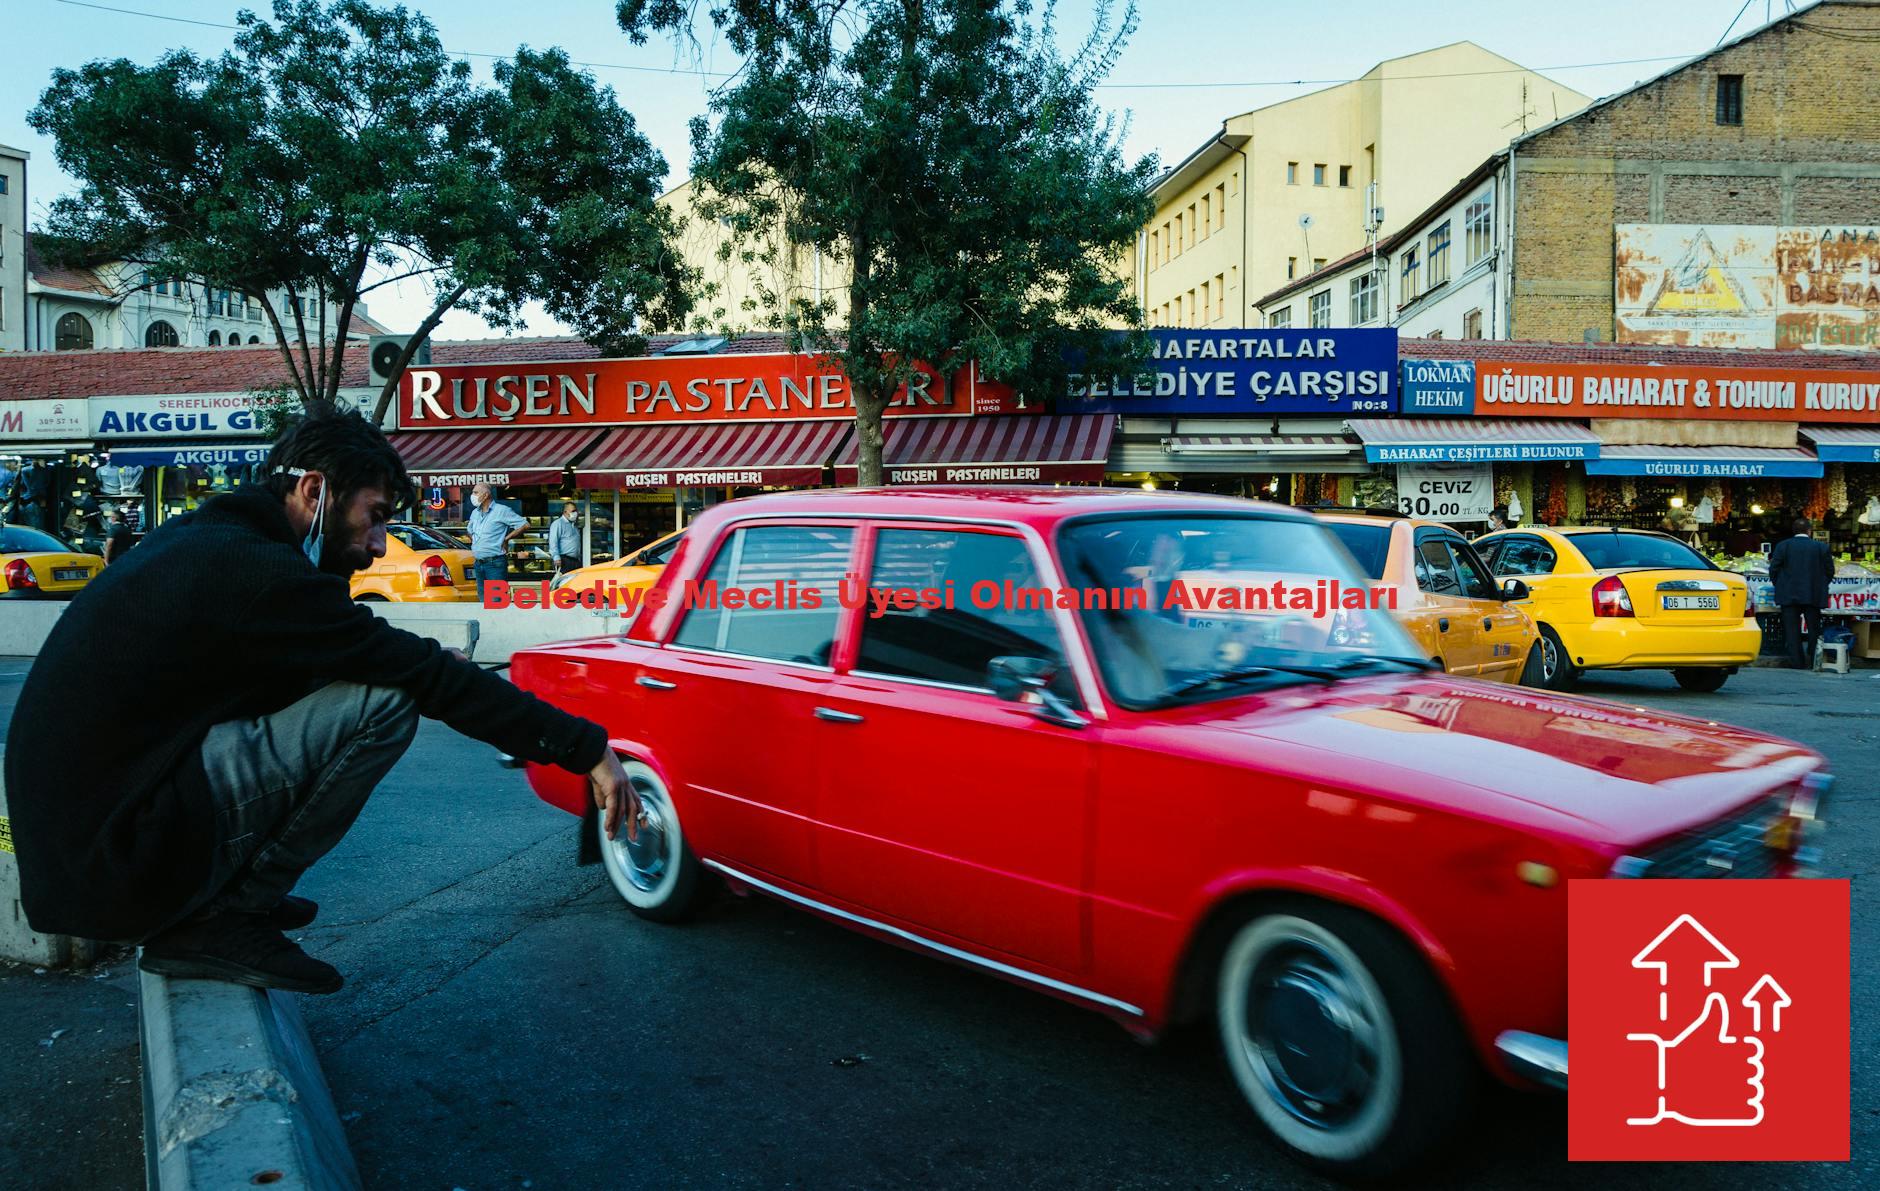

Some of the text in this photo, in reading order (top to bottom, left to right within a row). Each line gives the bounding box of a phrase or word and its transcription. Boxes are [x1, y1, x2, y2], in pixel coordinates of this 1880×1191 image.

[1407, 366, 1472, 384] LOKMAN
[410, 370, 597, 421] RUŞEN
[1250, 371, 1389, 402] ÇARŞISI
[1483, 368, 1574, 406] UĞURLU
[1582, 376, 1689, 407] BAHARAT
[1715, 379, 1796, 409] TOHUM
[1805, 382, 1880, 411] KURUY
[1352, 400, 1389, 411] NO:8
[1415, 387, 1465, 407] HEKİM
[99, 410, 218, 433] AKGÜL
[173, 451, 239, 465] AKGÜL
[1380, 444, 1585, 463] BAHARAT ÇEŞİTLERİ BULUNUR
[891, 470, 938, 484] RUŞEN
[1645, 461, 1765, 475] UĞURLU BAHARAT
[626, 473, 668, 488] RUŞEN
[1400, 497, 1459, 516] 30.00
[1668, 597, 1718, 608] 06 T 5560
